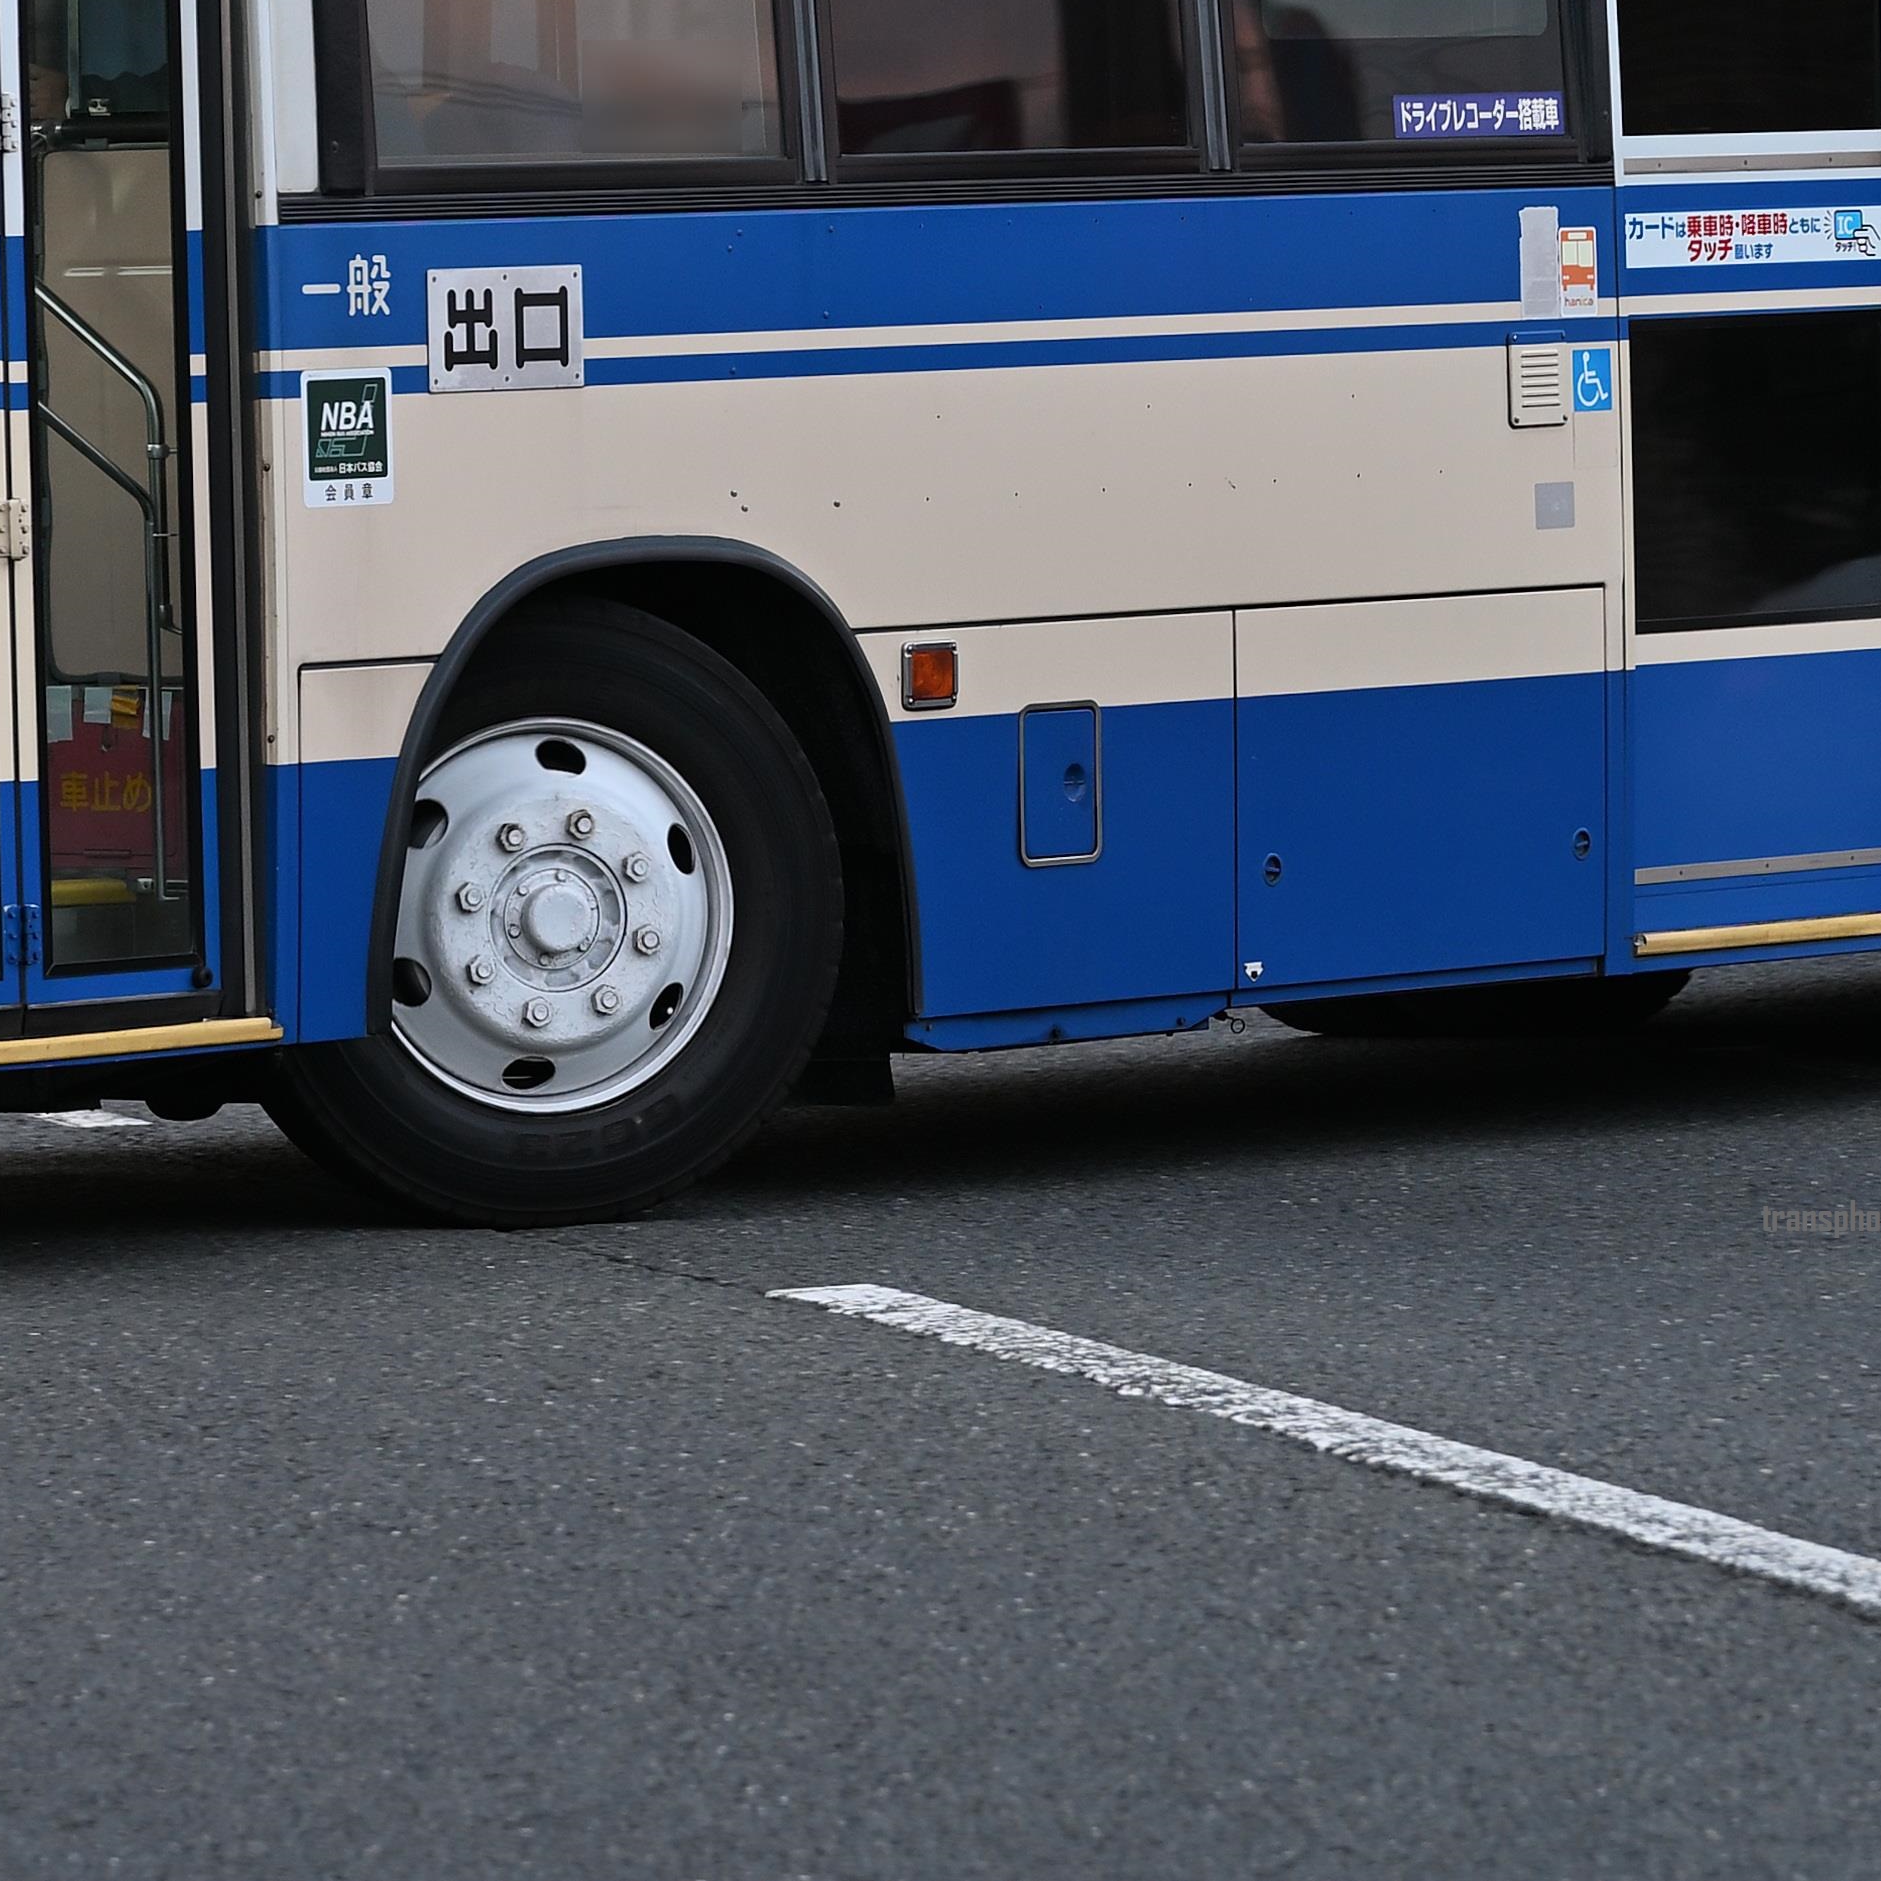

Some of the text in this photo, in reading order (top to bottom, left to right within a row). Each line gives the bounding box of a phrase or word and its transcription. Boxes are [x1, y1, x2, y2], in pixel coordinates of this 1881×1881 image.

[1400, 97, 1560, 133] ドライブレコーダー搭載車
[301, 253, 392, 317] 一般
[1563, 293, 1595, 308] hanica
[443, 284, 571, 372] 出口
[320, 399, 375, 432] NBA
[324, 481, 374, 502] 会員章
[59, 770, 153, 813] 車止め
